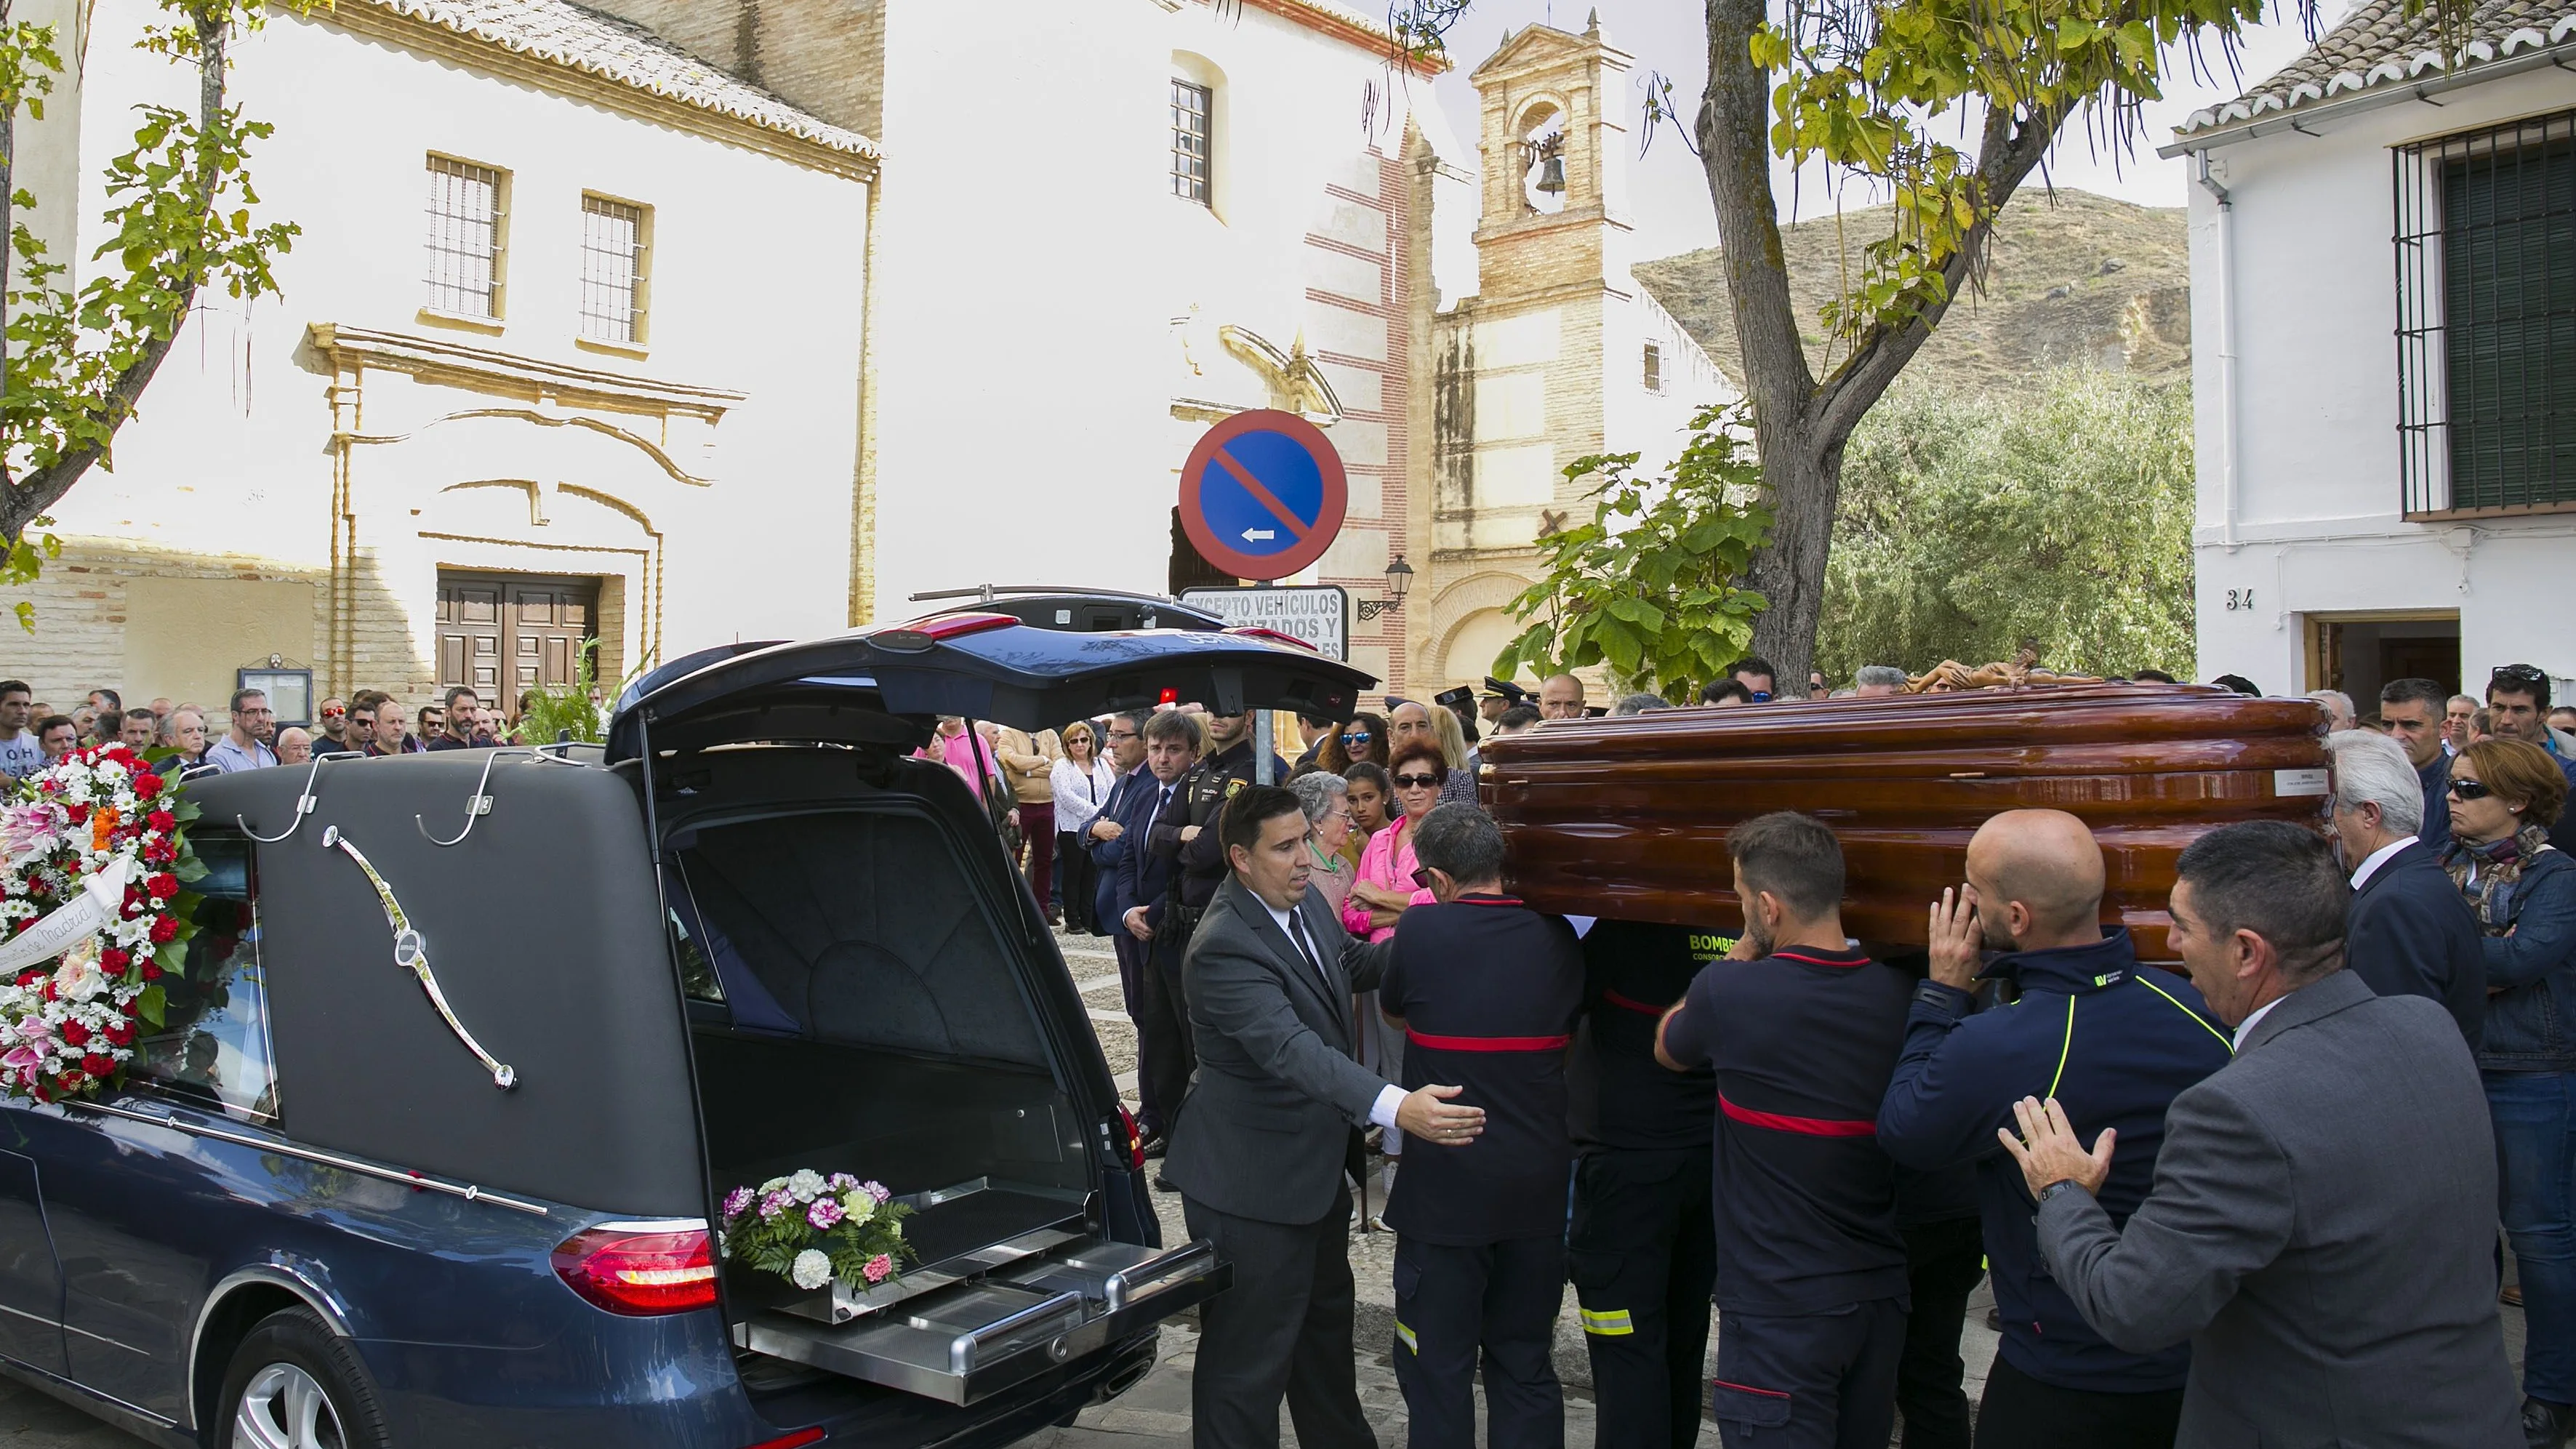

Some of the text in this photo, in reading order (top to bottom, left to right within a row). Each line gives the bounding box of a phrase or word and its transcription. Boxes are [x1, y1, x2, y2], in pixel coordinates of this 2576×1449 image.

[1255, 592, 1338, 617] VEHÍCULOS
[2226, 589, 2252, 610] 34
[1325, 617, 1338, 638] Y
[37, 902, 92, 944] Madrid
[1690, 935, 1740, 952] BOMBE
